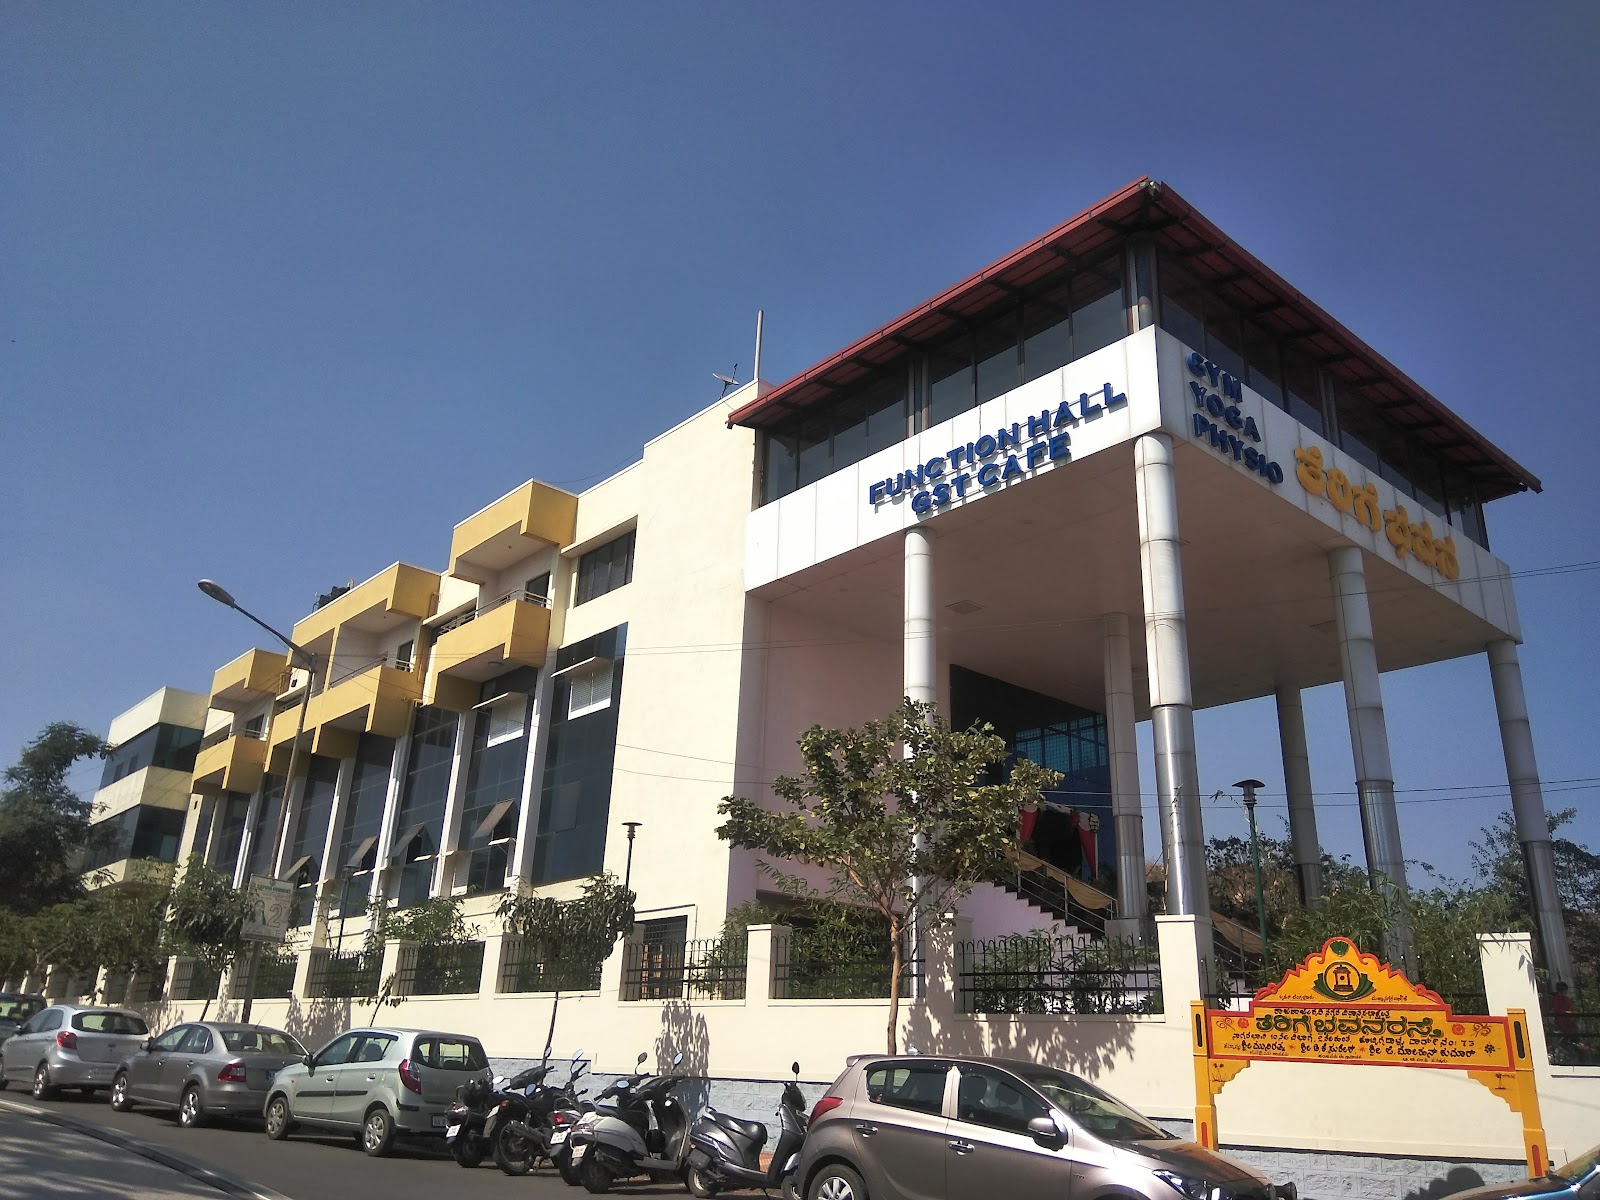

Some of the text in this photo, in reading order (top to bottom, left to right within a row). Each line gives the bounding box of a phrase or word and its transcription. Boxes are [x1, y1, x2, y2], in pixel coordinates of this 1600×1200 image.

[1186, 352, 1243, 403] GYM
[1189, 381, 1261, 443] YOGA
[869, 382, 1127, 505] FUNCTION HALL
[912, 432, 1070, 514] GST CAFE
[1192, 413, 1283, 485] PHYSIO
